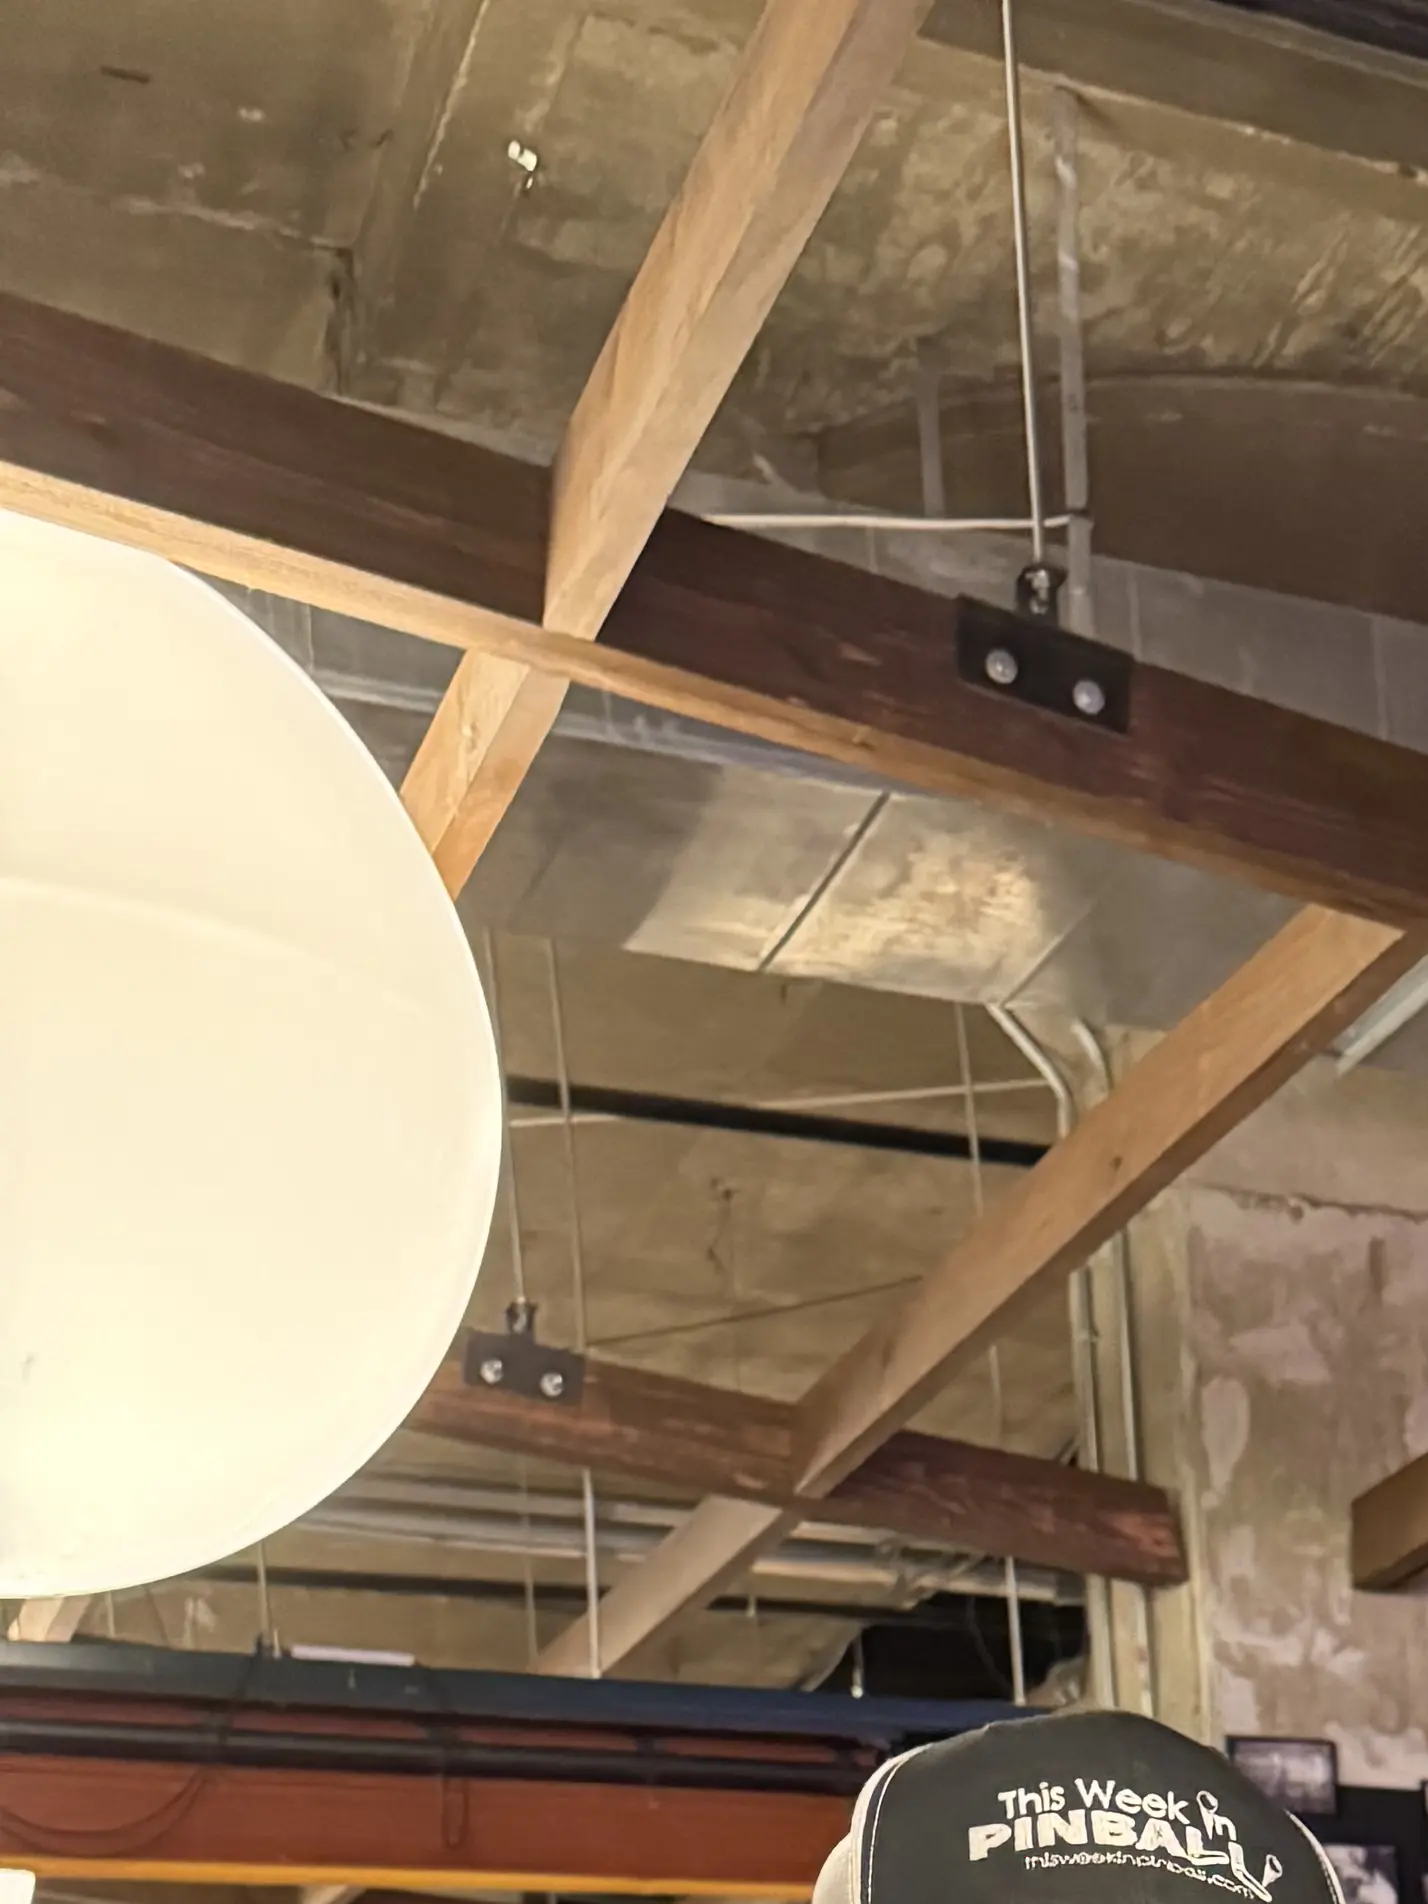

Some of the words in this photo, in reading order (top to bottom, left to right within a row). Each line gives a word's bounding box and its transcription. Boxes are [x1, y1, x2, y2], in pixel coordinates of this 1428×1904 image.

[998, 1781, 1065, 1819] This
[1074, 1777, 1190, 1825] Week
[1196, 1790, 1237, 1841] in
[968, 1808, 1272, 1903] PINBALL
